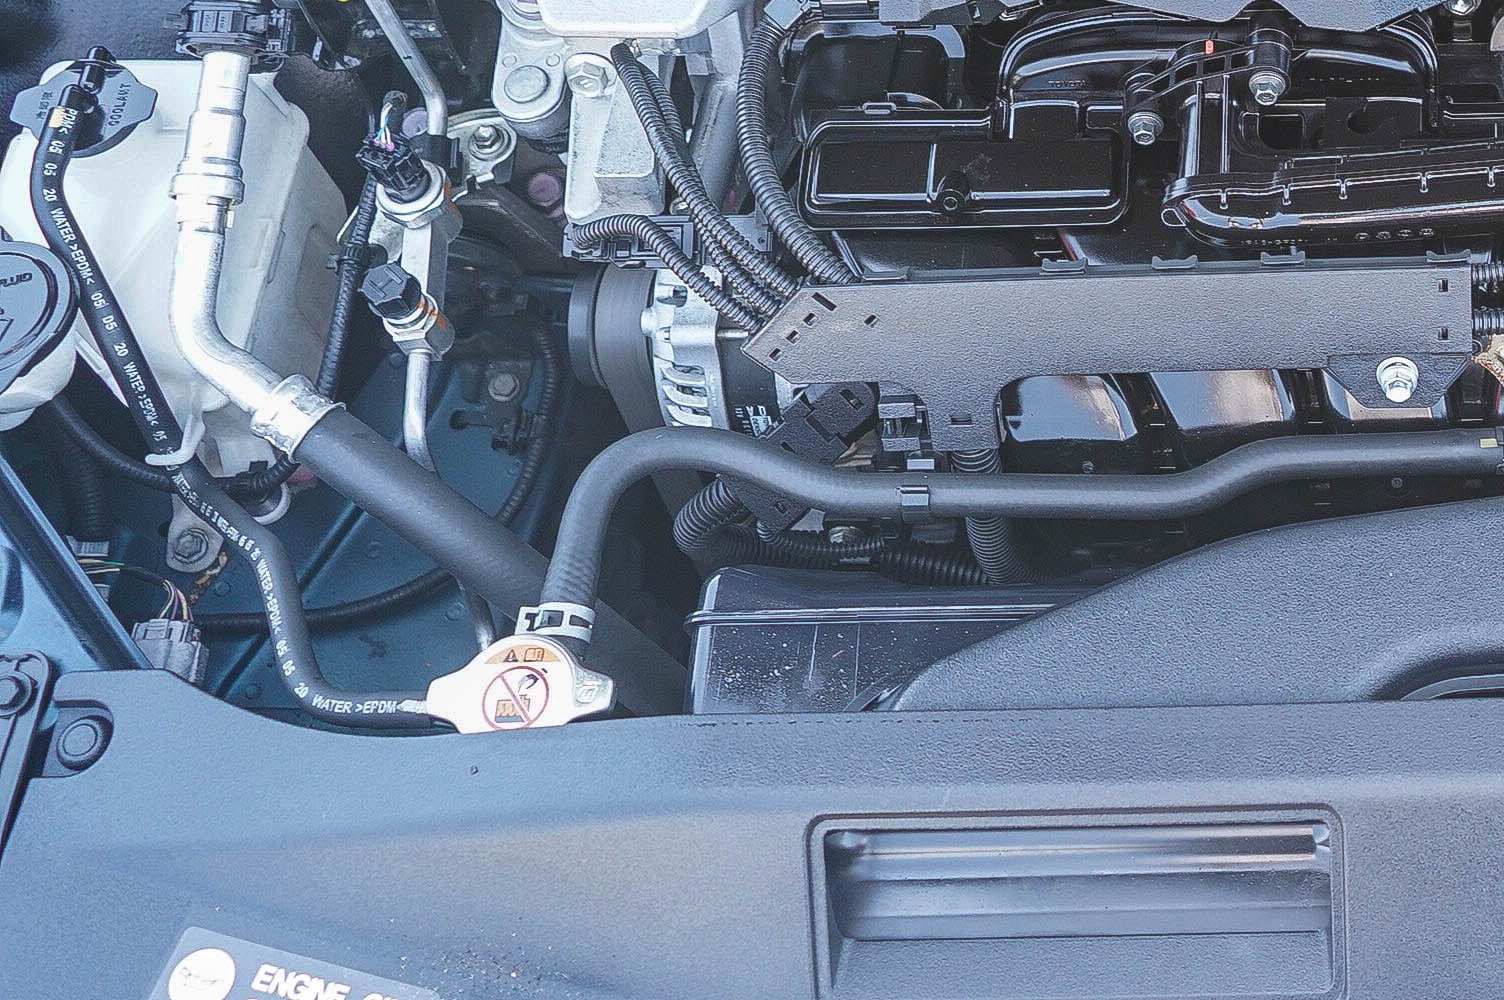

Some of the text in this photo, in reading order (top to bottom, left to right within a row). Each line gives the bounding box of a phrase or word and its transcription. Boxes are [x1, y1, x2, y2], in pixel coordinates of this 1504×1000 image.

[108, 83, 131, 127] COOLANT
[42, 188, 57, 202] 20
[50, 208, 74, 243] WATER
[68, 244, 95, 285] >EPDM<
[113, 342, 128, 356] 20
[256, 559, 274, 593] WATER
[266, 594, 282, 634] >EPDM<
[293, 682, 309, 699] 20
[311, 694, 352, 714] WATER
[250, 962, 352, 1000] ENGINE
